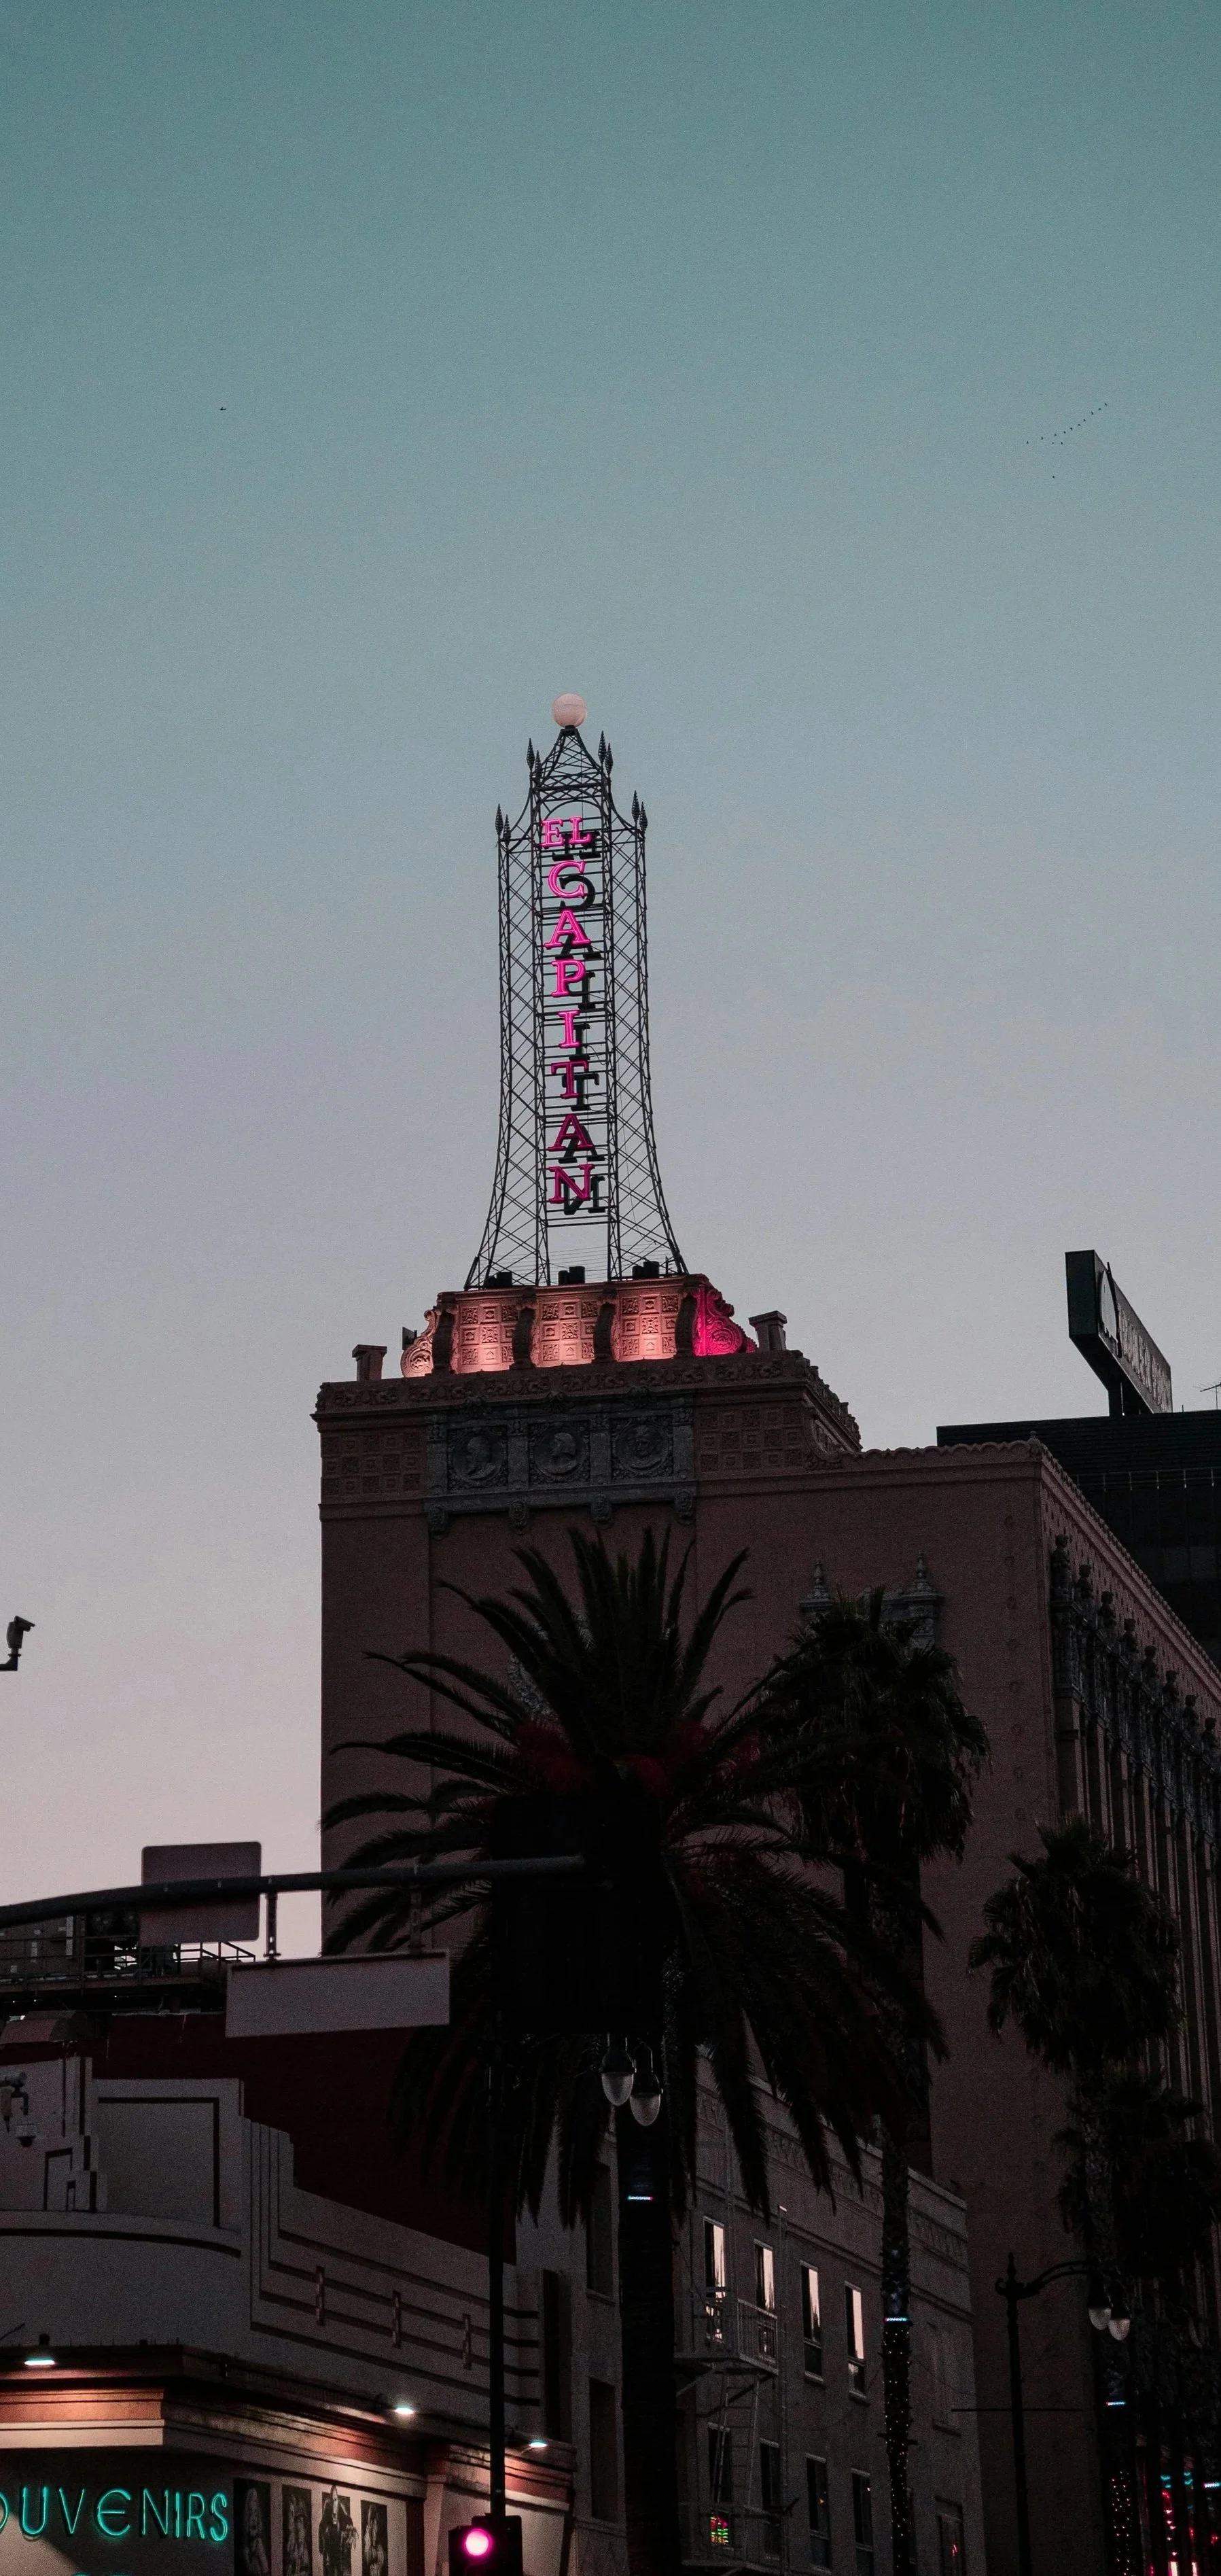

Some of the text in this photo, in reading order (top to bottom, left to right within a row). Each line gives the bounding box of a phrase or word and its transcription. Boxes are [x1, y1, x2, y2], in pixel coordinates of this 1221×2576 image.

[539, 816, 592, 848] EL
[544, 860, 595, 1204] CAPITAN
[0, 2484, 229, 2542] UVENIRS
